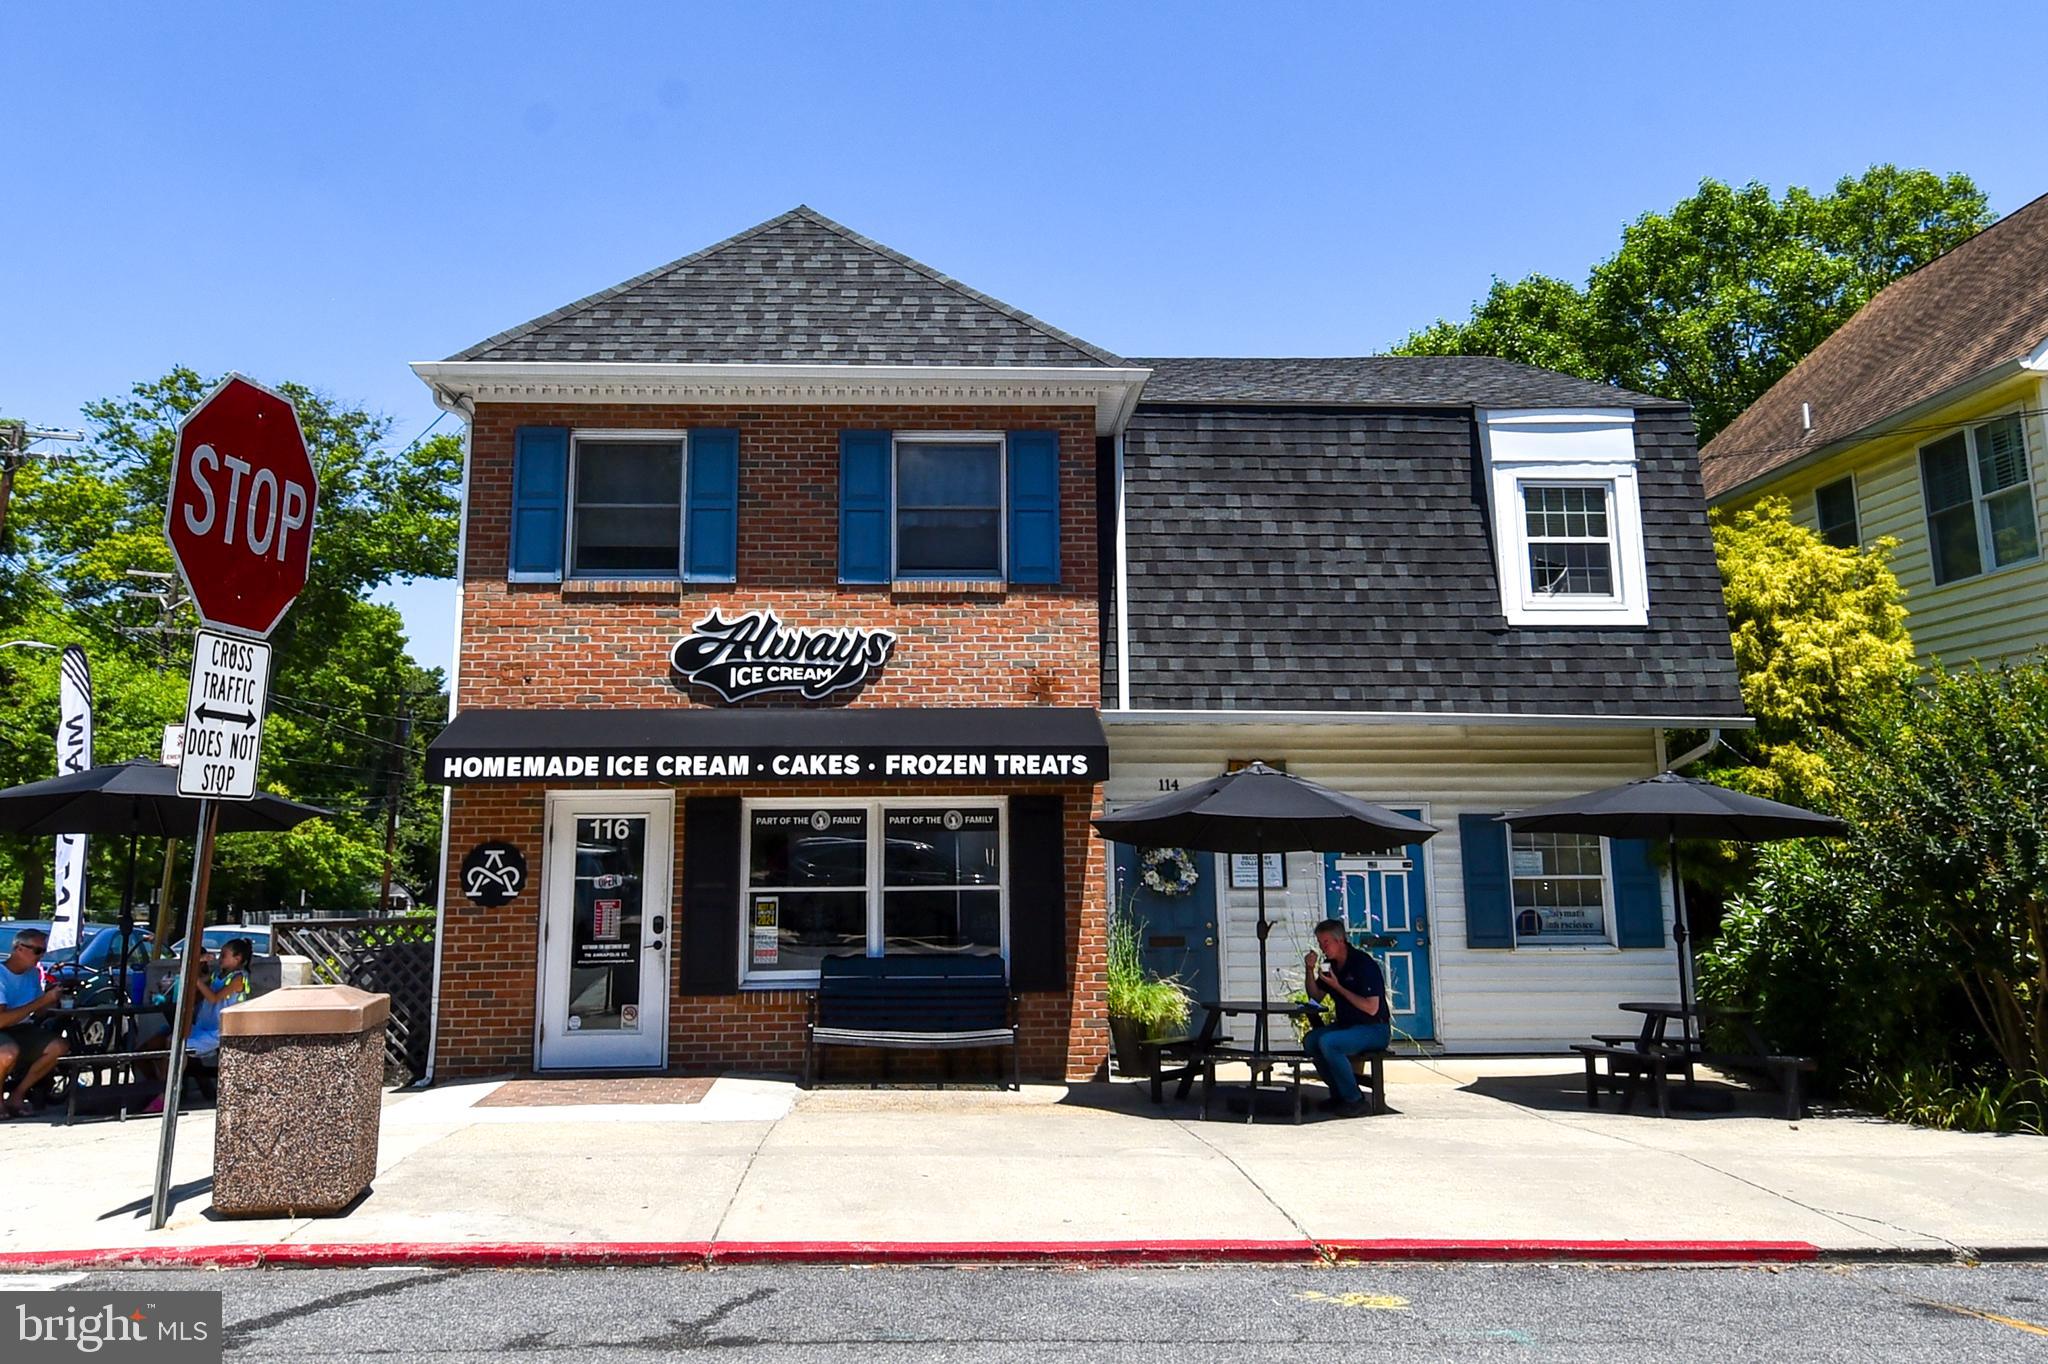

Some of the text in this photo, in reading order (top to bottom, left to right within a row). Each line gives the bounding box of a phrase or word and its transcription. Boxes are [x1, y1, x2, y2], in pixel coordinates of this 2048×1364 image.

[184, 444, 307, 561] STOP
[673, 610, 894, 674] Always
[212, 640, 254, 673] CROSS
[730, 666, 833, 688] ICE CREAM
[204, 672, 256, 706] TRAFFIC
[188, 728, 256, 761] DOES NOT
[443, 754, 1088, 777] HOMEMADE ICE CREAM CAKES FROZEN TREATS
[202, 764, 235, 792] STOP
[1159, 778, 1179, 791] 114
[590, 819, 630, 840] 116
[756, 816, 862, 825] PART OF THE FAMILY
[889, 815, 994, 825] PART OF THE FAMILY
[598, 874, 618, 888] OPEN
